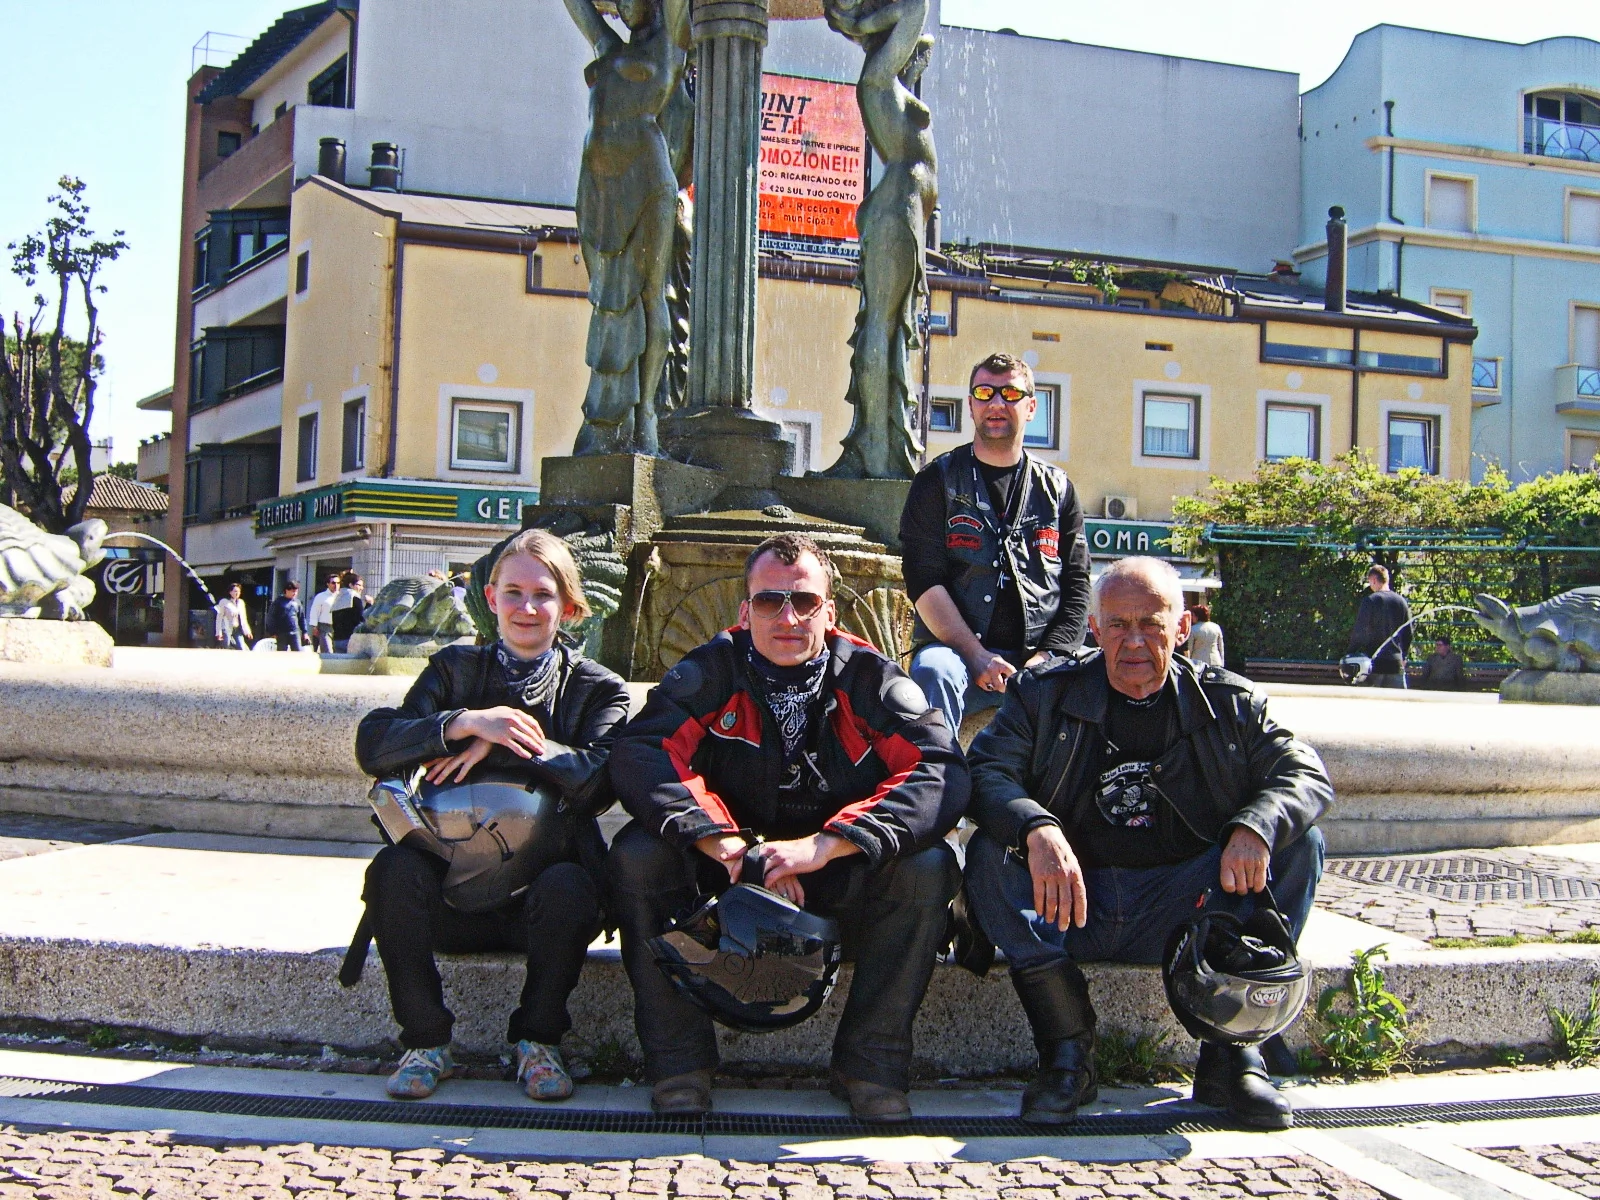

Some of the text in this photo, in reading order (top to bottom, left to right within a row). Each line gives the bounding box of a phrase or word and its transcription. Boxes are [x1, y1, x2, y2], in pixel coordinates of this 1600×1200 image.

[761, 112, 805, 135] ET.it
[791, 139, 826, 149] SPORTIVE
[833, 143, 861, 153] IPPICHE
[761, 170, 778, 179] CO:
[780, 172, 841, 185] RICARICANDO
[769, 185, 785, 193] €20
[787, 187, 804, 196] SUL
[806, 188, 825, 198] TUO
[826, 190, 857, 201] CONTO
[796, 202, 841, 215] Riccione
[761, 240, 808, 251] RICCIONE
[262, 493, 338, 527] GELATERIA PIMPI
[477, 497, 541, 520] GEL
